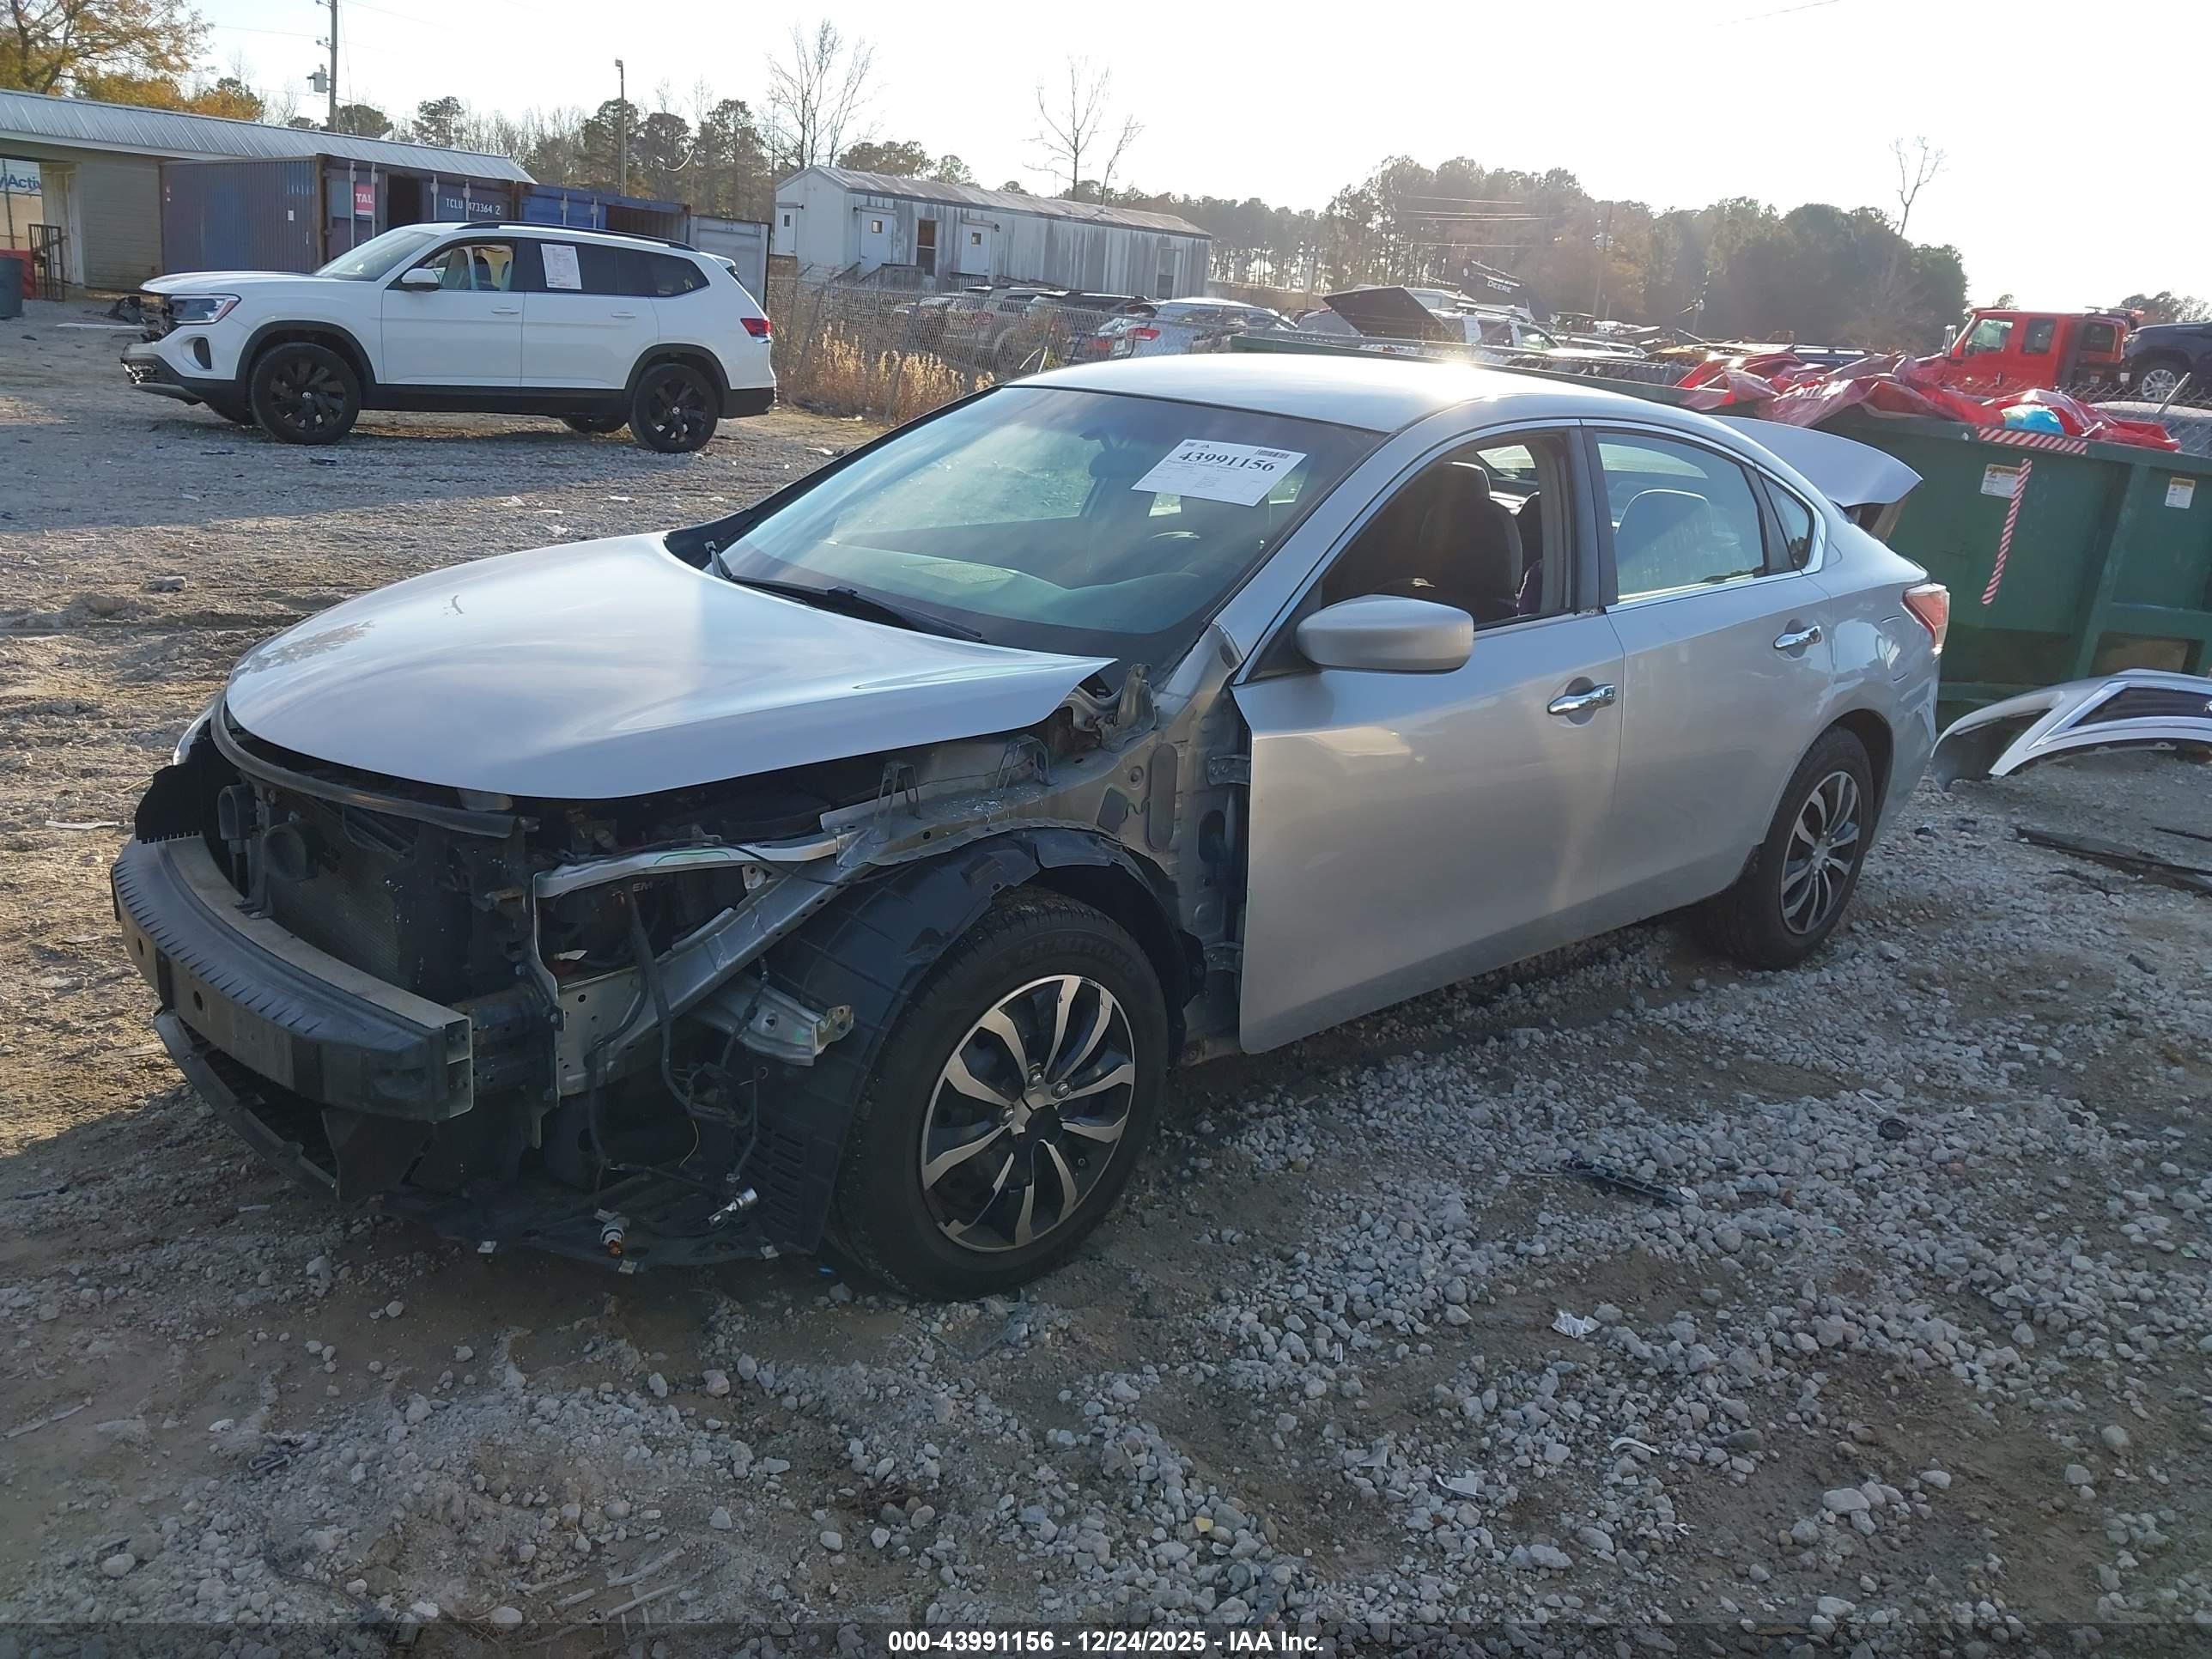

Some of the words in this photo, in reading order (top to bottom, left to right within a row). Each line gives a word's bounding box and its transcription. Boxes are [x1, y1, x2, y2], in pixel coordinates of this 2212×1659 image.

[355, 192, 373, 204] TAL
[446, 198, 464, 210] TCLU
[495, 204, 501, 216] 2
[1486, 280, 1511, 294] DEERE
[1178, 451, 1278, 471] 43991156
